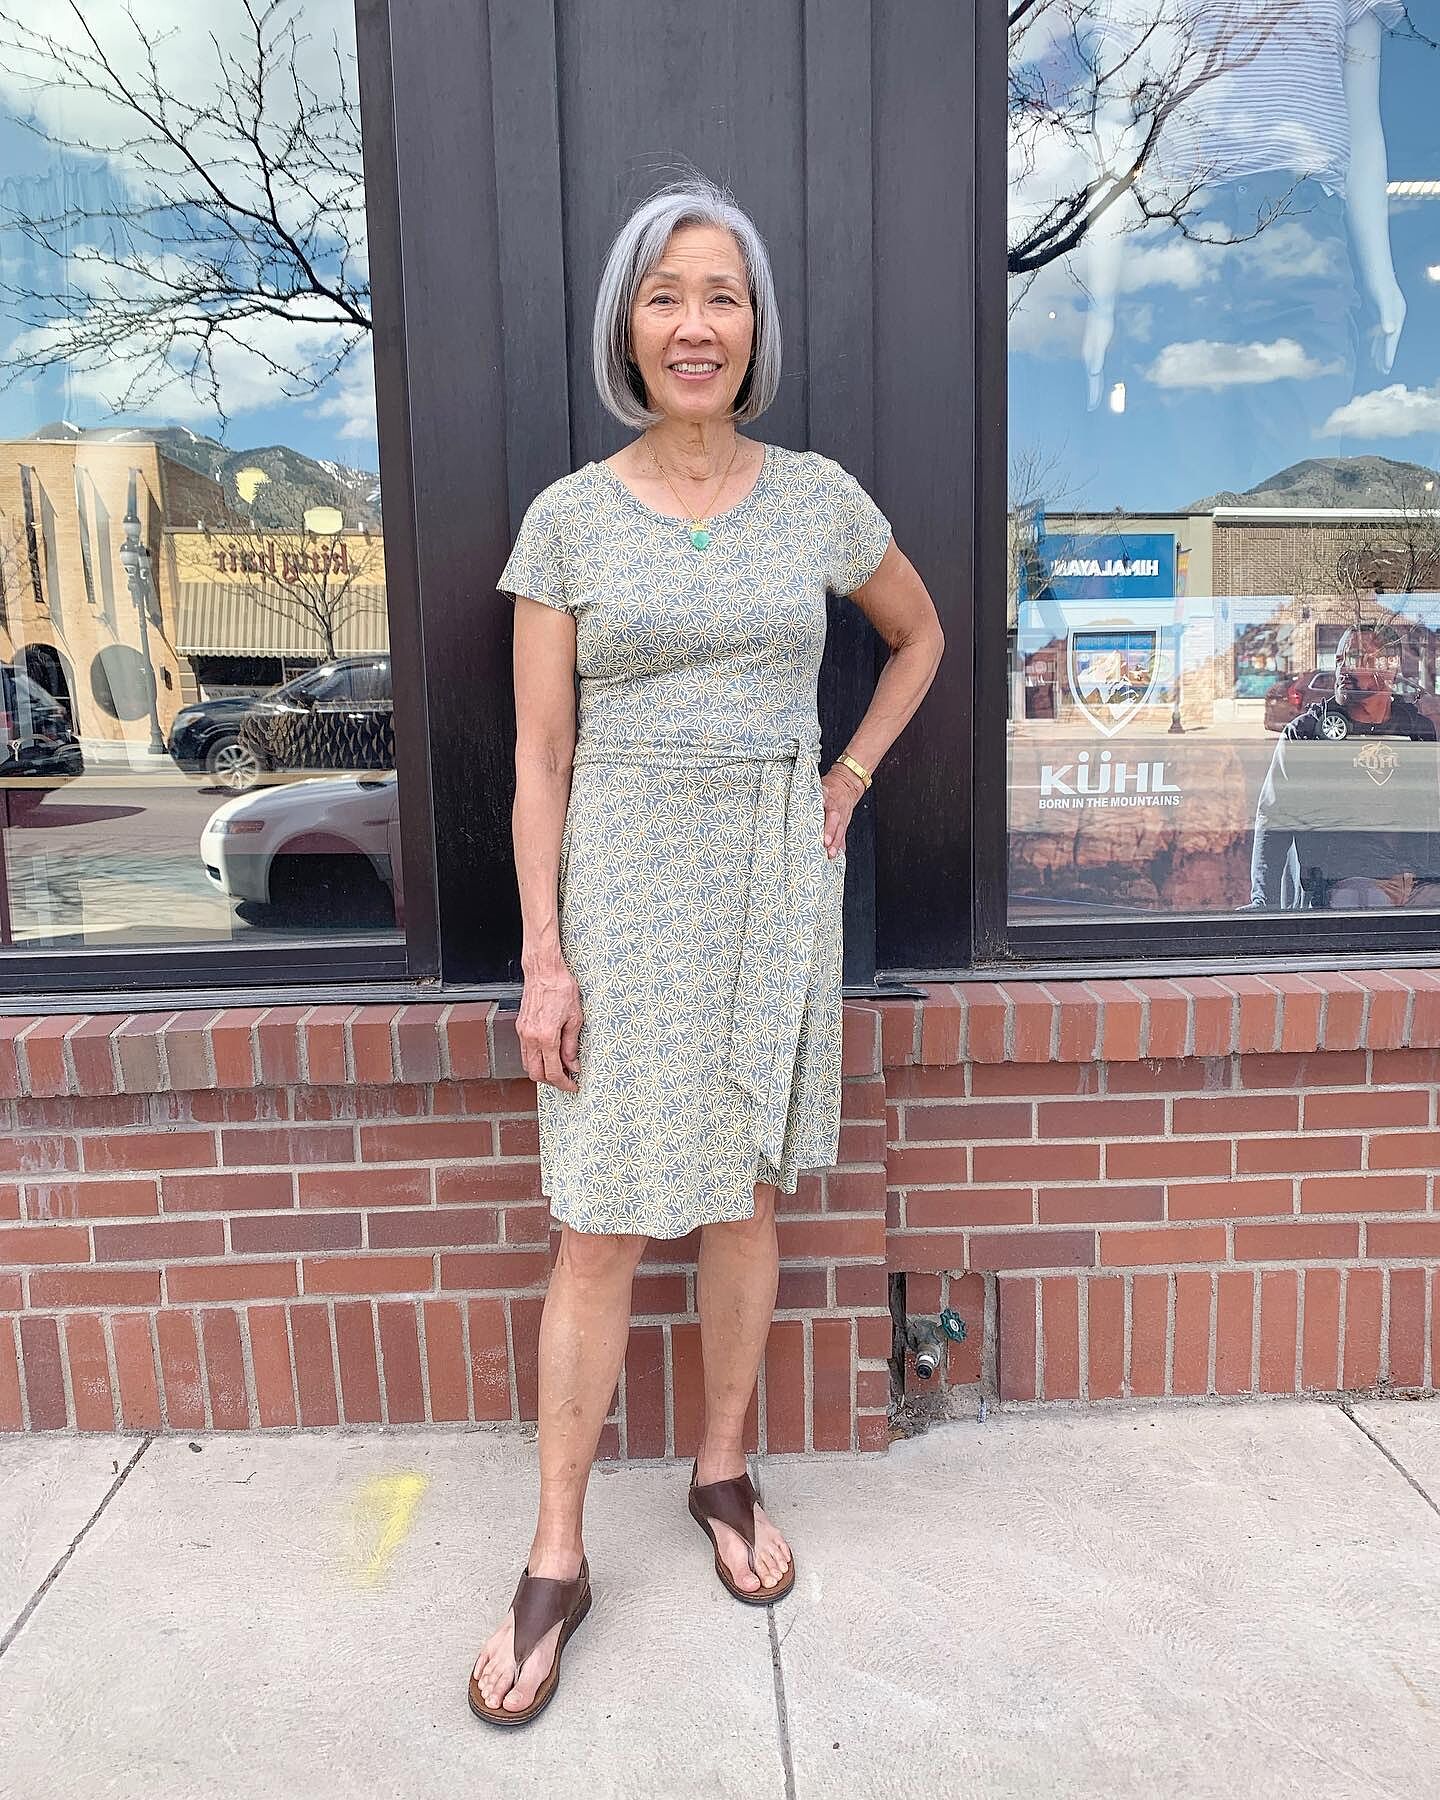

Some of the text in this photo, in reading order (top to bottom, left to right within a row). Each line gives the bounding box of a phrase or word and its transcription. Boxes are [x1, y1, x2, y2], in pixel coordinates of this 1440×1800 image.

[1040, 750, 1182, 795] KÜHL
[1039, 795, 1180, 809] BORN IN THE MOUNTAINS
